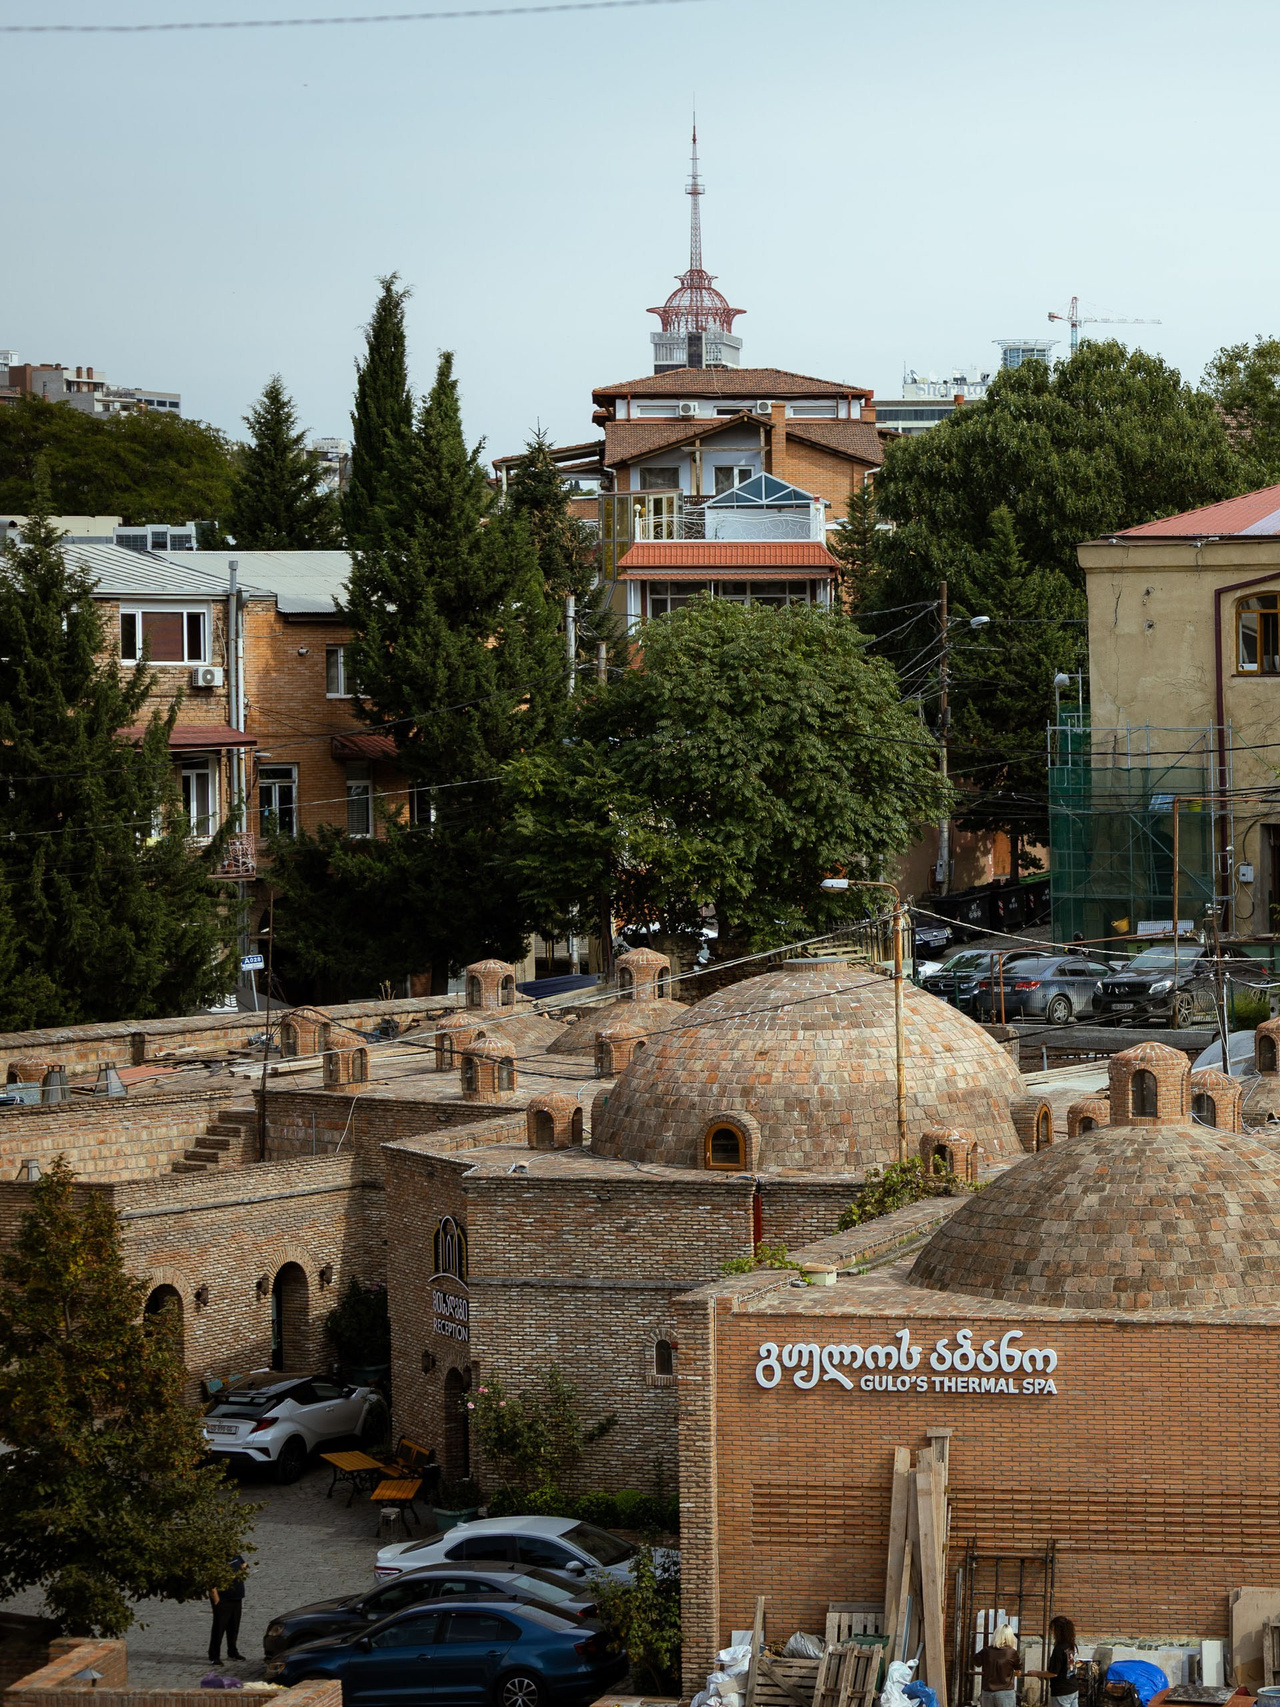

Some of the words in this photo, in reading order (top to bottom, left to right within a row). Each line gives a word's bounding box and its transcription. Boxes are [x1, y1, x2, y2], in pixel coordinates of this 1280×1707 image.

[915, 383, 987, 397] Sherato
[433, 1317, 468, 1342] RECEPTION
[755, 1328, 922, 1389] გულოს
[929, 1328, 1058, 1373] აბანო
[860, 1374, 928, 1392] GULO’S
[931, 1376, 1019, 1394] THERMAL
[1022, 1378, 1057, 1395] SPA
